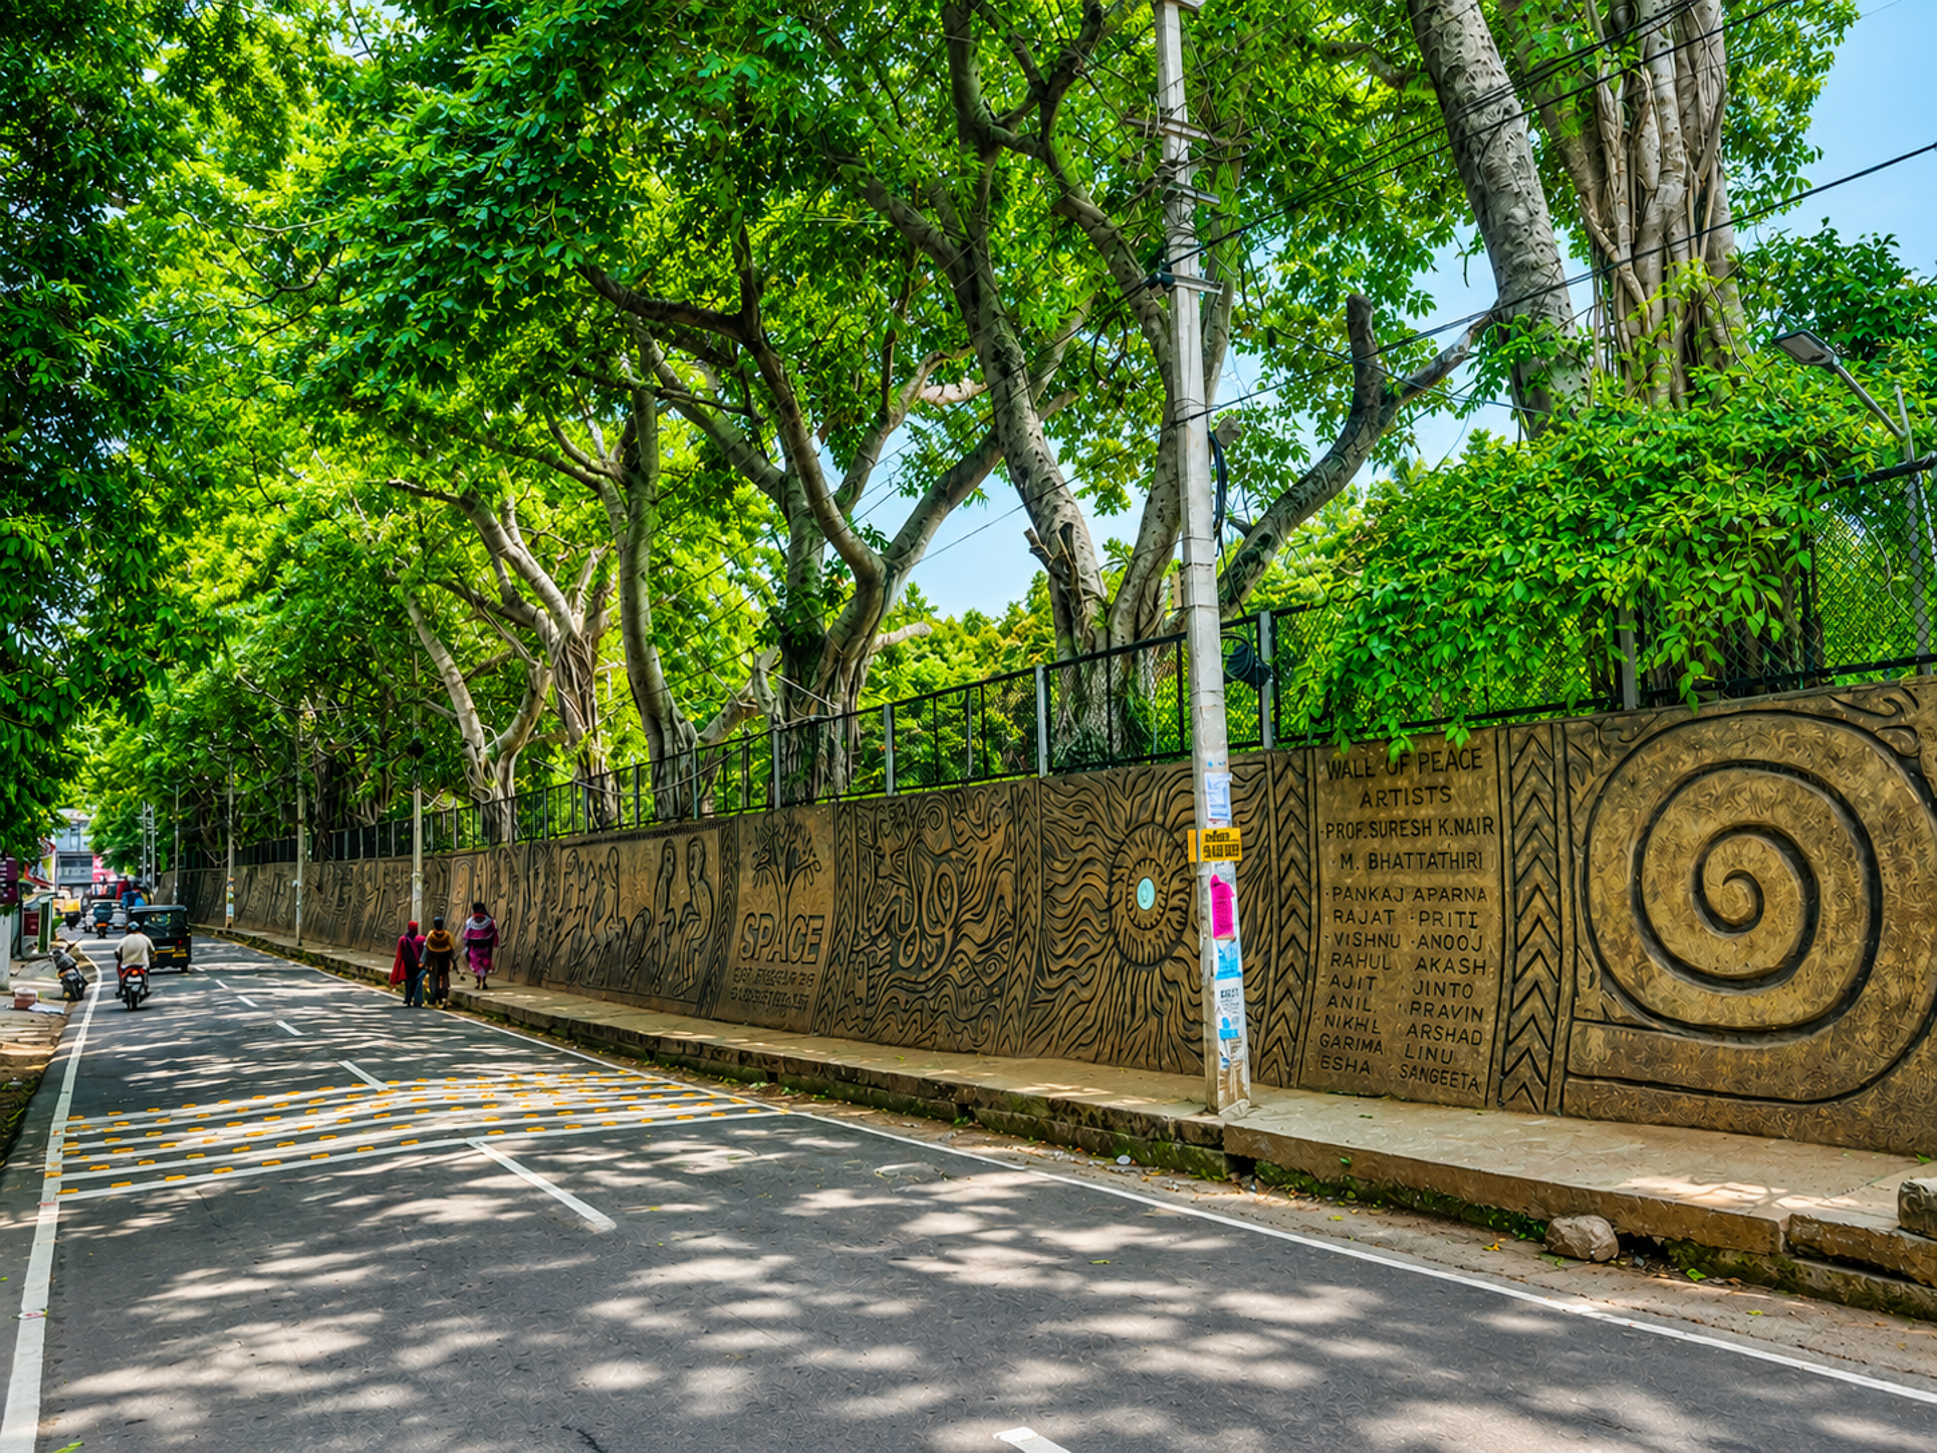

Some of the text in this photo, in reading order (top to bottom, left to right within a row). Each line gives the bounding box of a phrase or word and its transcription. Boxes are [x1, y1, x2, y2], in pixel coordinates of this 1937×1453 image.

[1326, 748, 1483, 780] WALL OF PEACE
[1359, 785, 1451, 808] ARTISTS
[1368, 852, 1483, 870] BHATTATHIRI
[1332, 886, 1404, 902] PANKAJ
[1412, 887, 1488, 902] APARNA
[1333, 909, 1395, 925] RAJAT
[1418, 911, 1478, 929] PRITI
[740, 912, 825, 964] SPACE
[1334, 932, 1400, 948] VISHNU
[1417, 934, 1483, 952] ANOOJ
[1330, 953, 1391, 971] RAHUL
[1414, 956, 1486, 976] AKASH
[1329, 974, 1377, 991] AJIT
[1412, 980, 1473, 999] JINTO
[1409, 1001, 1483, 1022] PRAVIN
[1405, 1022, 1483, 1046] ARSHAD
[1319, 1033, 1383, 1055] GARIMA
[1404, 1043, 1453, 1065] LINU
[1320, 1055, 1371, 1075] ESHA
[1400, 1063, 1481, 1094] SANGEETA
